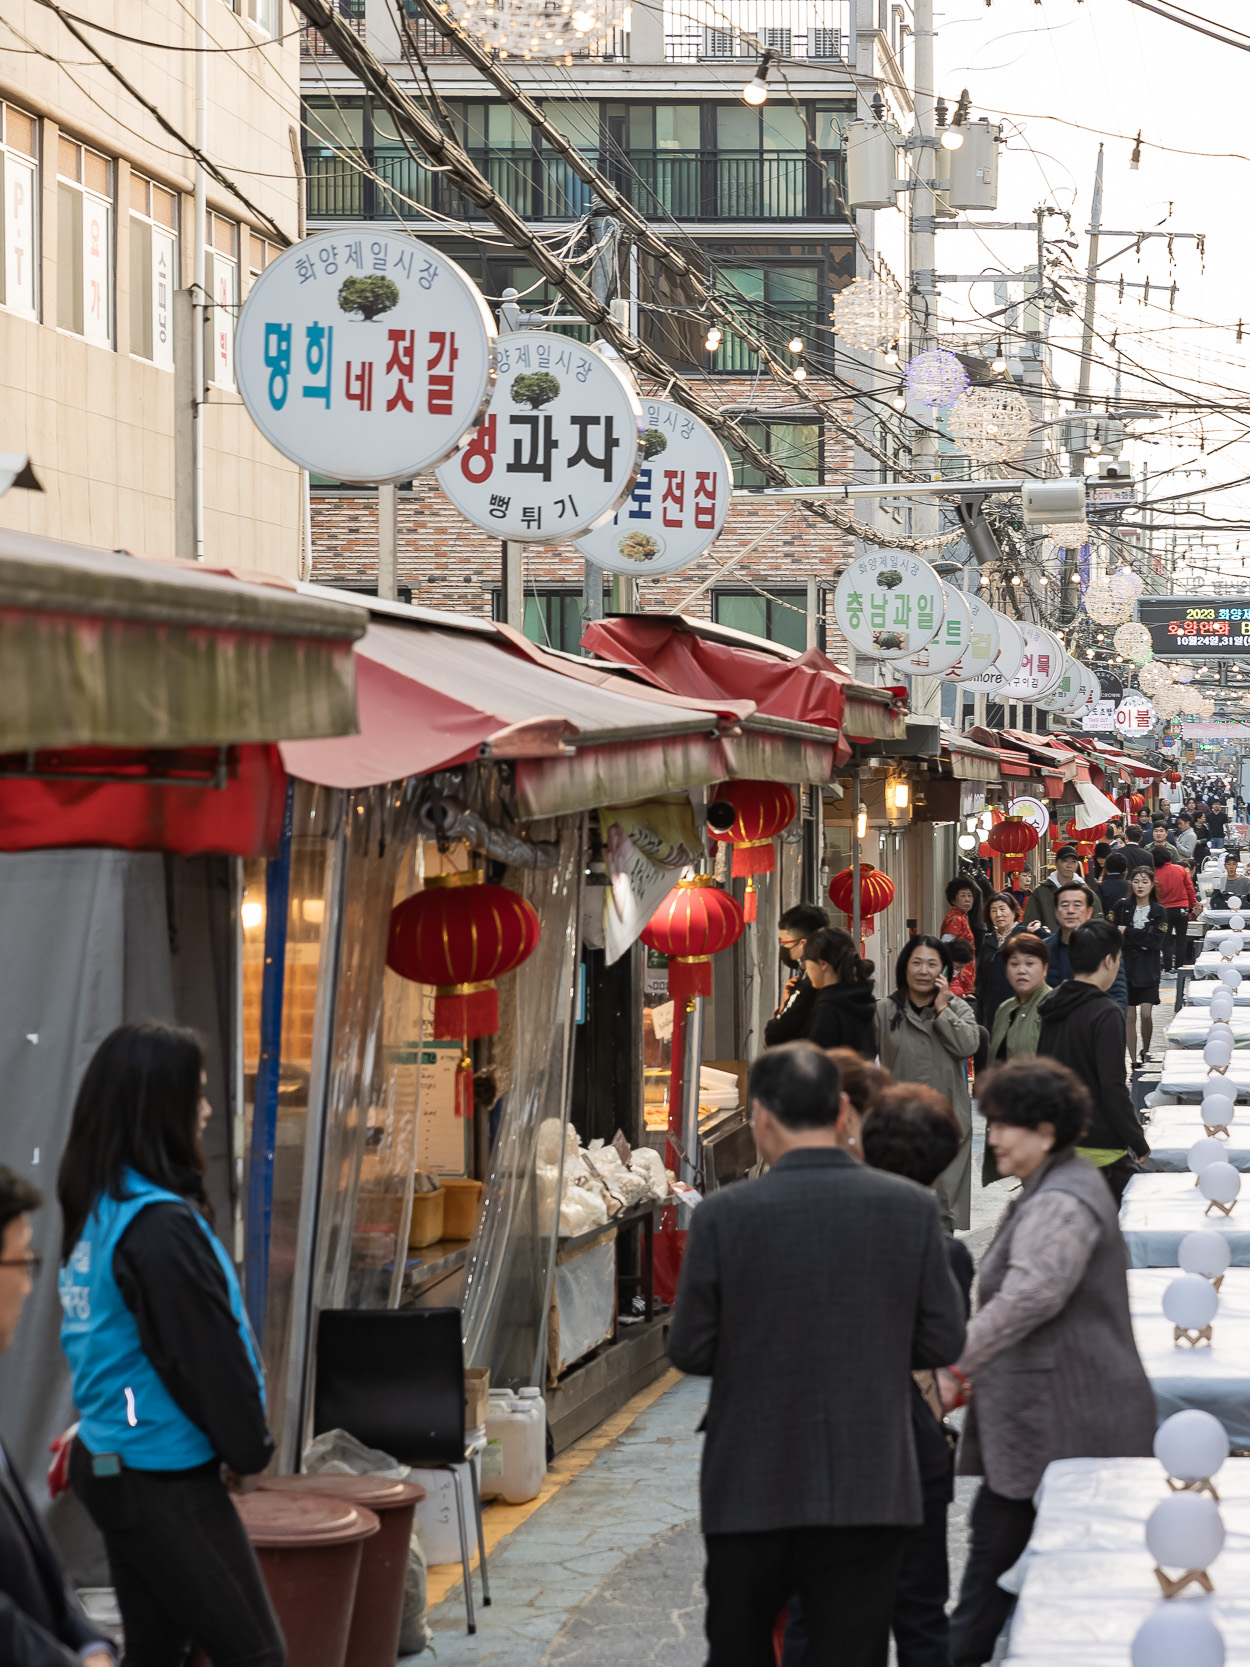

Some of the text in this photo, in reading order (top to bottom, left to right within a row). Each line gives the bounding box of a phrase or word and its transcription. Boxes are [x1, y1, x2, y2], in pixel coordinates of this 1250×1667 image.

[295, 240, 440, 291] 화양제일시장
[857, 554, 920, 577] 화양제일시장
[846, 591, 935, 631] 충남과일
[1186, 609, 1215, 620] 2023
[1116, 709, 1151, 728] 이불
